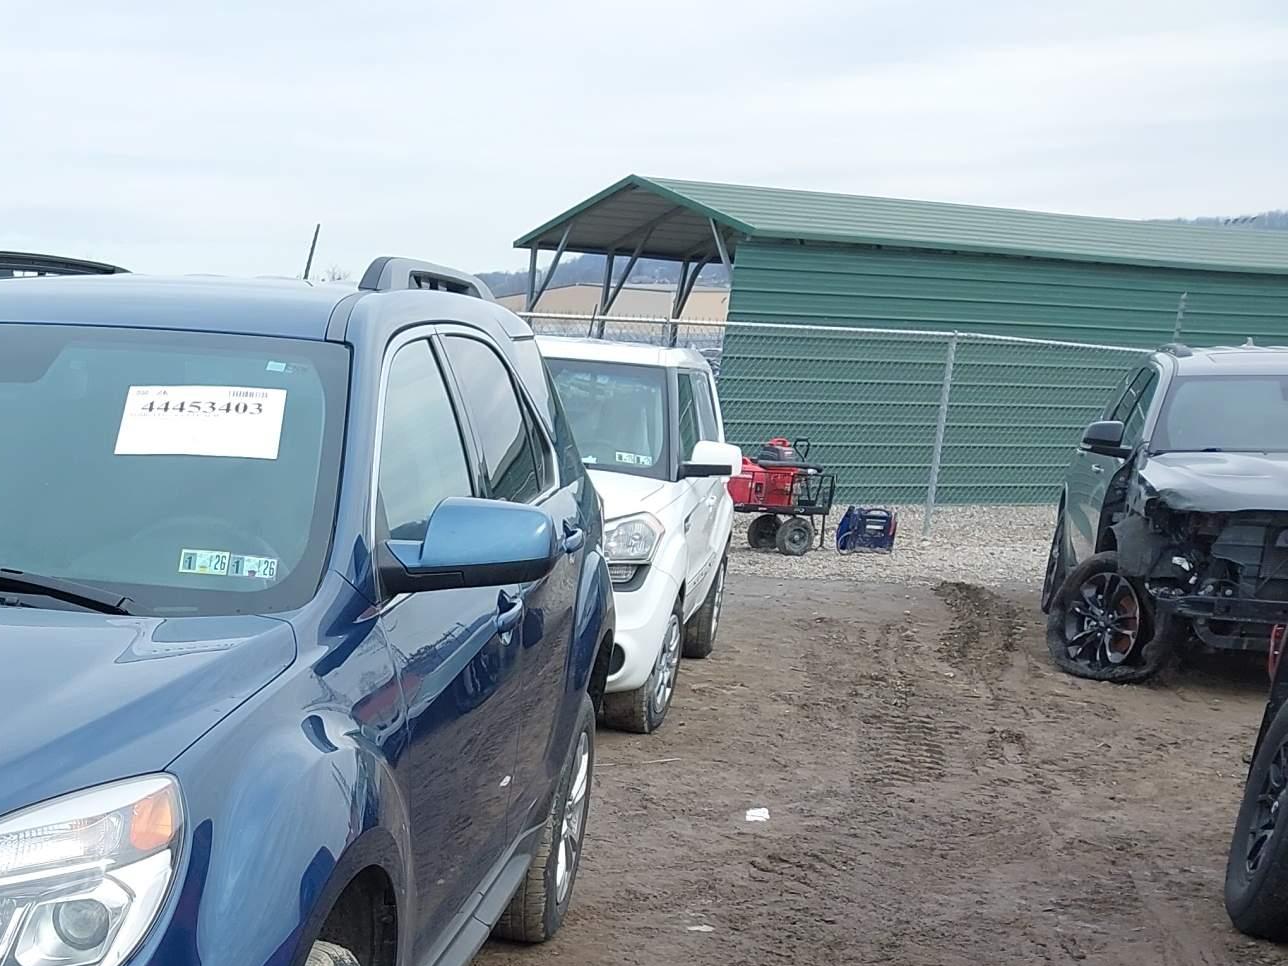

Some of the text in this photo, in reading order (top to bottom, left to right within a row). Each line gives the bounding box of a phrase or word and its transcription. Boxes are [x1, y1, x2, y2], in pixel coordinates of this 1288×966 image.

[140, 400, 264, 416] 44453403
[214, 554, 227, 571] 26
[263, 560, 276, 577] 26
